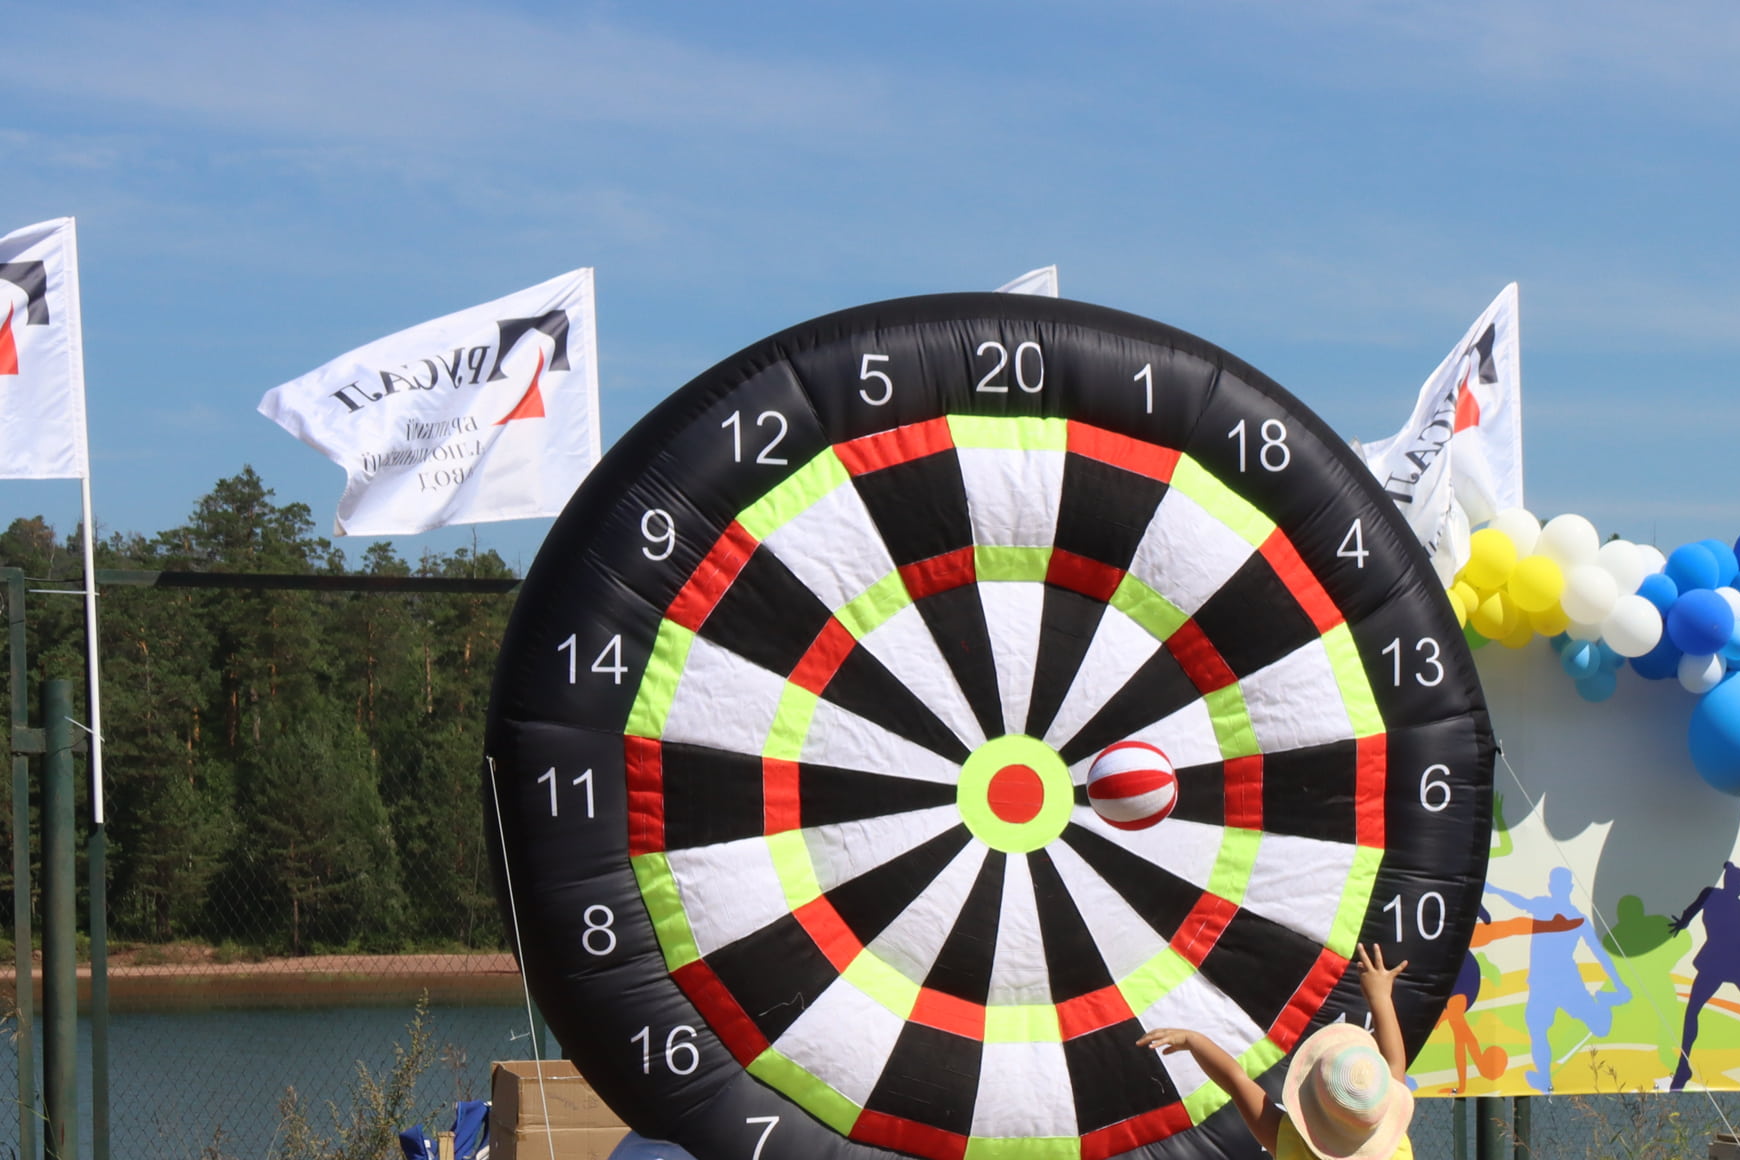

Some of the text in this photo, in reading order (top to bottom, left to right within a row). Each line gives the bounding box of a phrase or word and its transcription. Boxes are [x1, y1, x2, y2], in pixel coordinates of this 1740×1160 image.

[859, 353, 893, 406] 5
[976, 340, 1045, 394] 20
[1133, 362, 1153, 414] 1
[721, 410, 788, 466] 12
[1228, 417, 1291, 473] 18
[640, 508, 676, 561] 9
[1336, 517, 1370, 569] 4
[557, 633, 629, 685] 14
[1381, 636, 1445, 687] 13
[537, 766, 595, 819] 11
[1420, 763, 1451, 812] 6
[582, 904, 617, 956] 8
[1383, 891, 1446, 943] 10
[631, 1024, 700, 1075] 16
